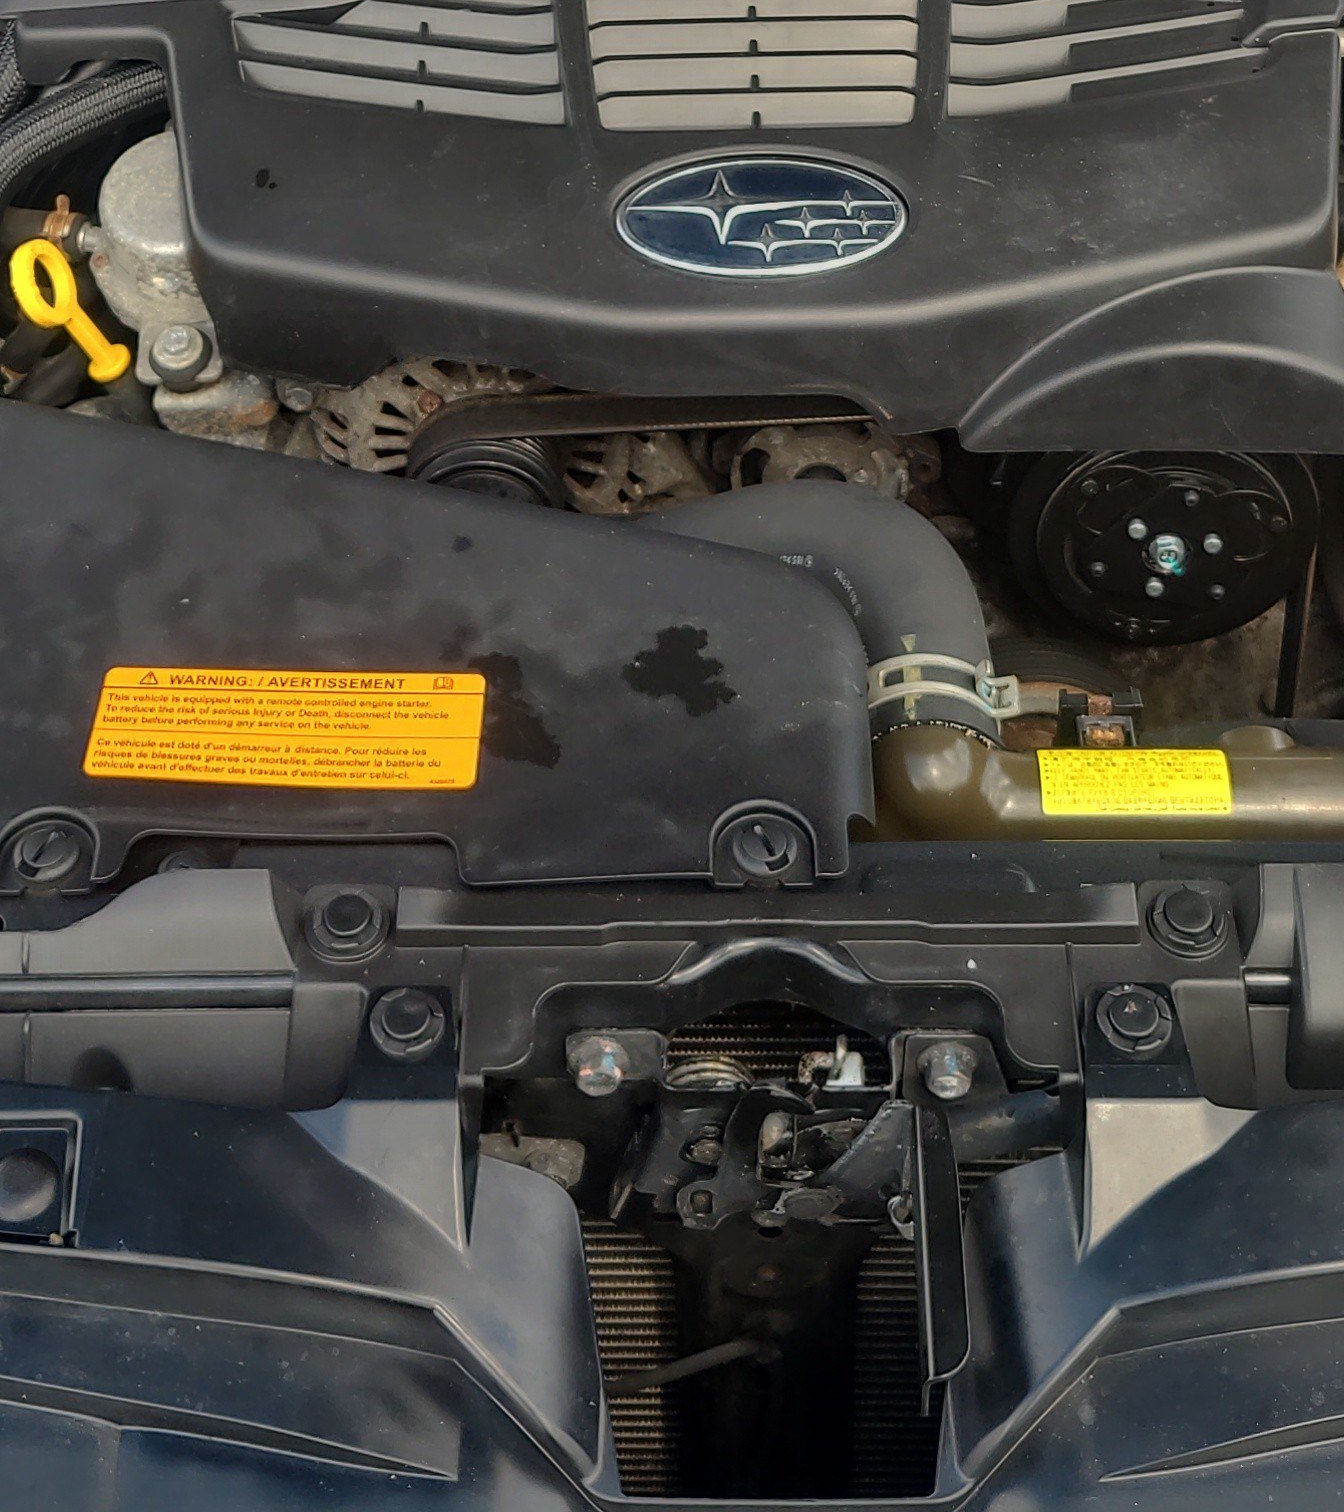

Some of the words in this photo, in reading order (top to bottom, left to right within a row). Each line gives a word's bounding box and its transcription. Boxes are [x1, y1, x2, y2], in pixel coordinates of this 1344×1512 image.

[170, 674, 253, 686] WARNING:
[258, 677, 263, 686] /
[268, 676, 406, 689] AVERTISSEMENT
[108, 693, 129, 701] This
[133, 694, 168, 703] vehicle
[172, 695, 180, 703] is
[183, 696, 231, 705] equipped
[306, 699, 356, 707] controlled
[359, 700, 393, 709] engine
[107, 704, 117, 712] To
[120, 705, 155, 713] reduce
[199, 707, 208, 715] of
[299, 710, 331, 718] Death,
[334, 711, 391, 719] disconnect
[394, 711, 409, 719] the
[103, 715, 138, 724] battery
[141, 716, 174, 724] before
[176, 717, 233, 728] performing
[258, 721, 294, 729] service
[314, 721, 330, 729] the
[334, 722, 371, 730] vehicle.
[98, 738, 110, 746] Ce
[178, 741, 200, 749] doté
[204, 742, 226, 750] d'un
[229, 743, 281, 752] démarreur
[284, 745, 290, 753] à
[295, 746, 340, 755] distance.
[345, 747, 369, 755] Pour
[372, 747, 409, 755] réduire
[412, 748, 426, 756] les
[94, 750, 132, 759] risques
[151, 752, 202, 761] blessures
[205, 756, 240, 764] graves
[258, 756, 310, 766] mortelles,
[313, 758, 371, 767] débrancher
[374, 759, 382, 767] la
[386, 759, 424, 767] batterie
[428, 760, 441, 768] du
[170, 763, 225, 774] d'effectuer
[227, 766, 246, 774] des
[249, 767, 288, 776] travaux
[291, 769, 346, 779] d'entretien
[370, 772, 409, 780] celui-ci.
